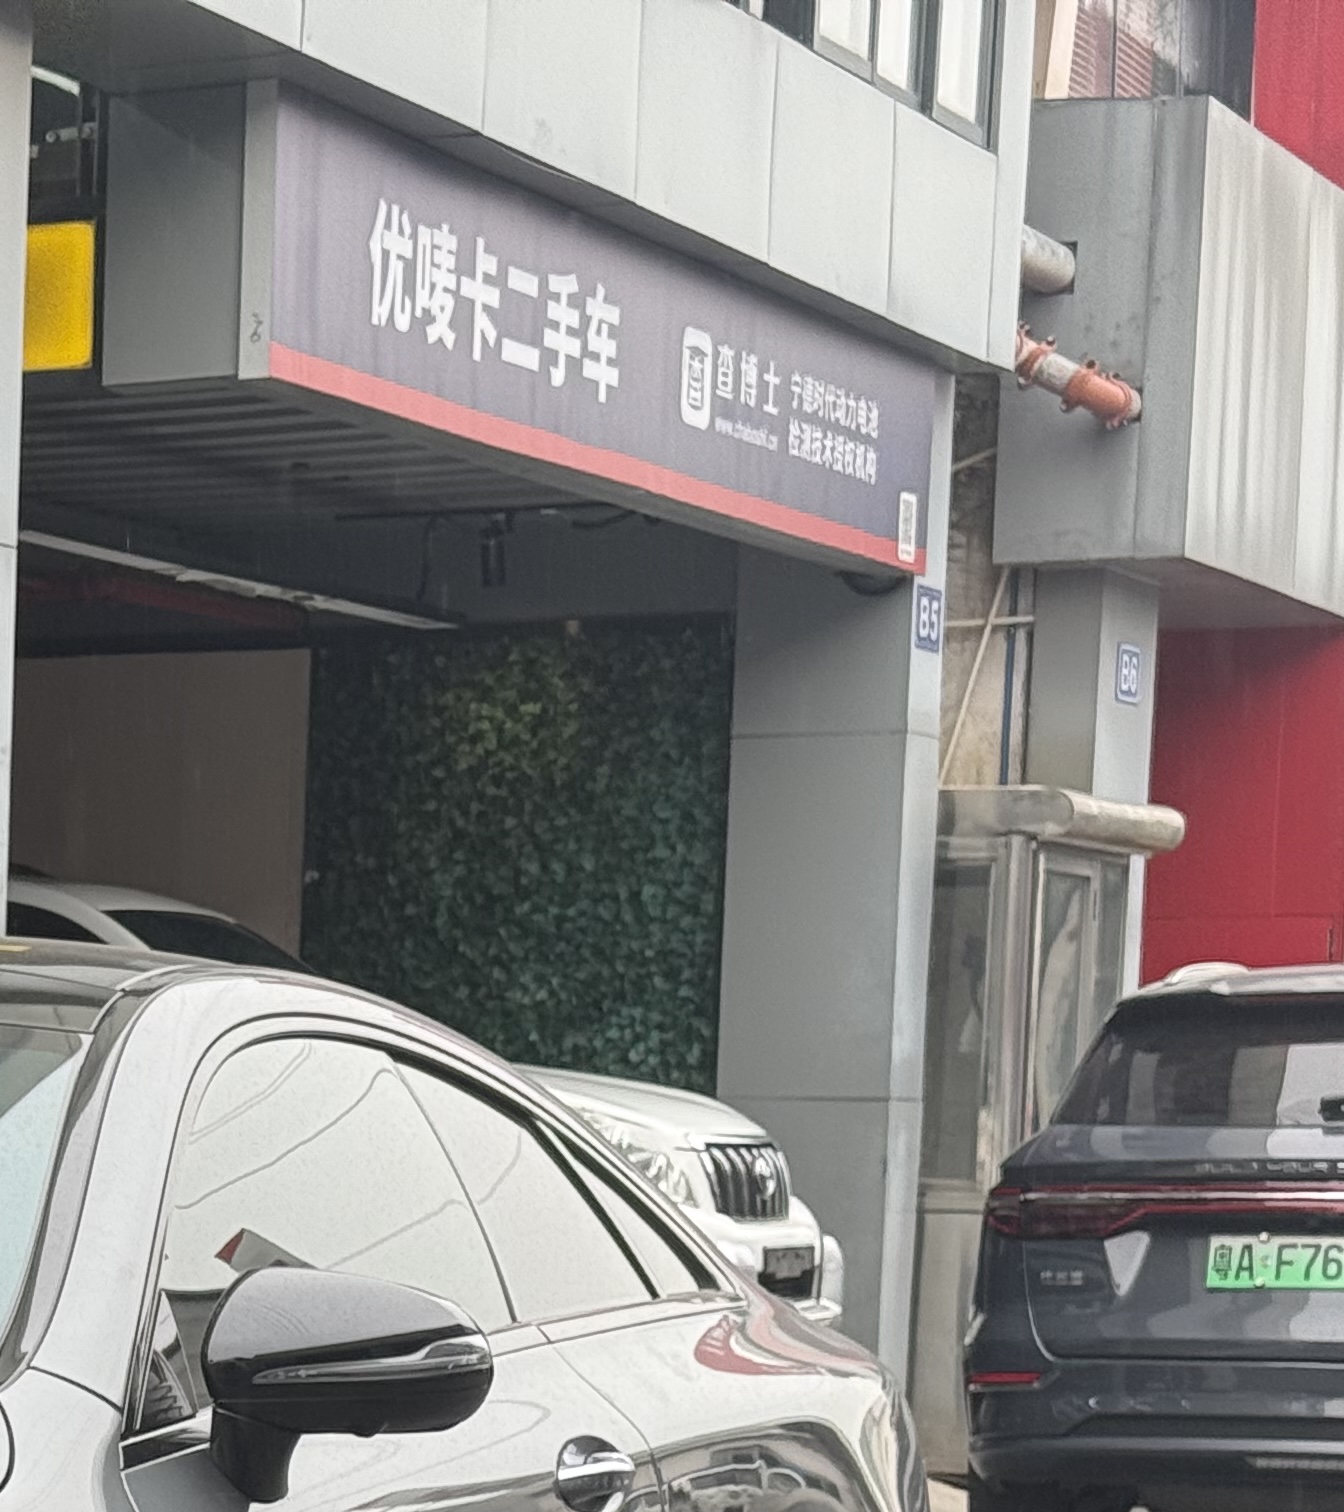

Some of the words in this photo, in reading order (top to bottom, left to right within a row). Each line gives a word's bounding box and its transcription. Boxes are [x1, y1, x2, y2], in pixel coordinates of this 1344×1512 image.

[369, 197, 621, 404] 优唛卡二手车
[715, 344, 781, 416] 查博士
[1120, 654, 1139, 694] B6
